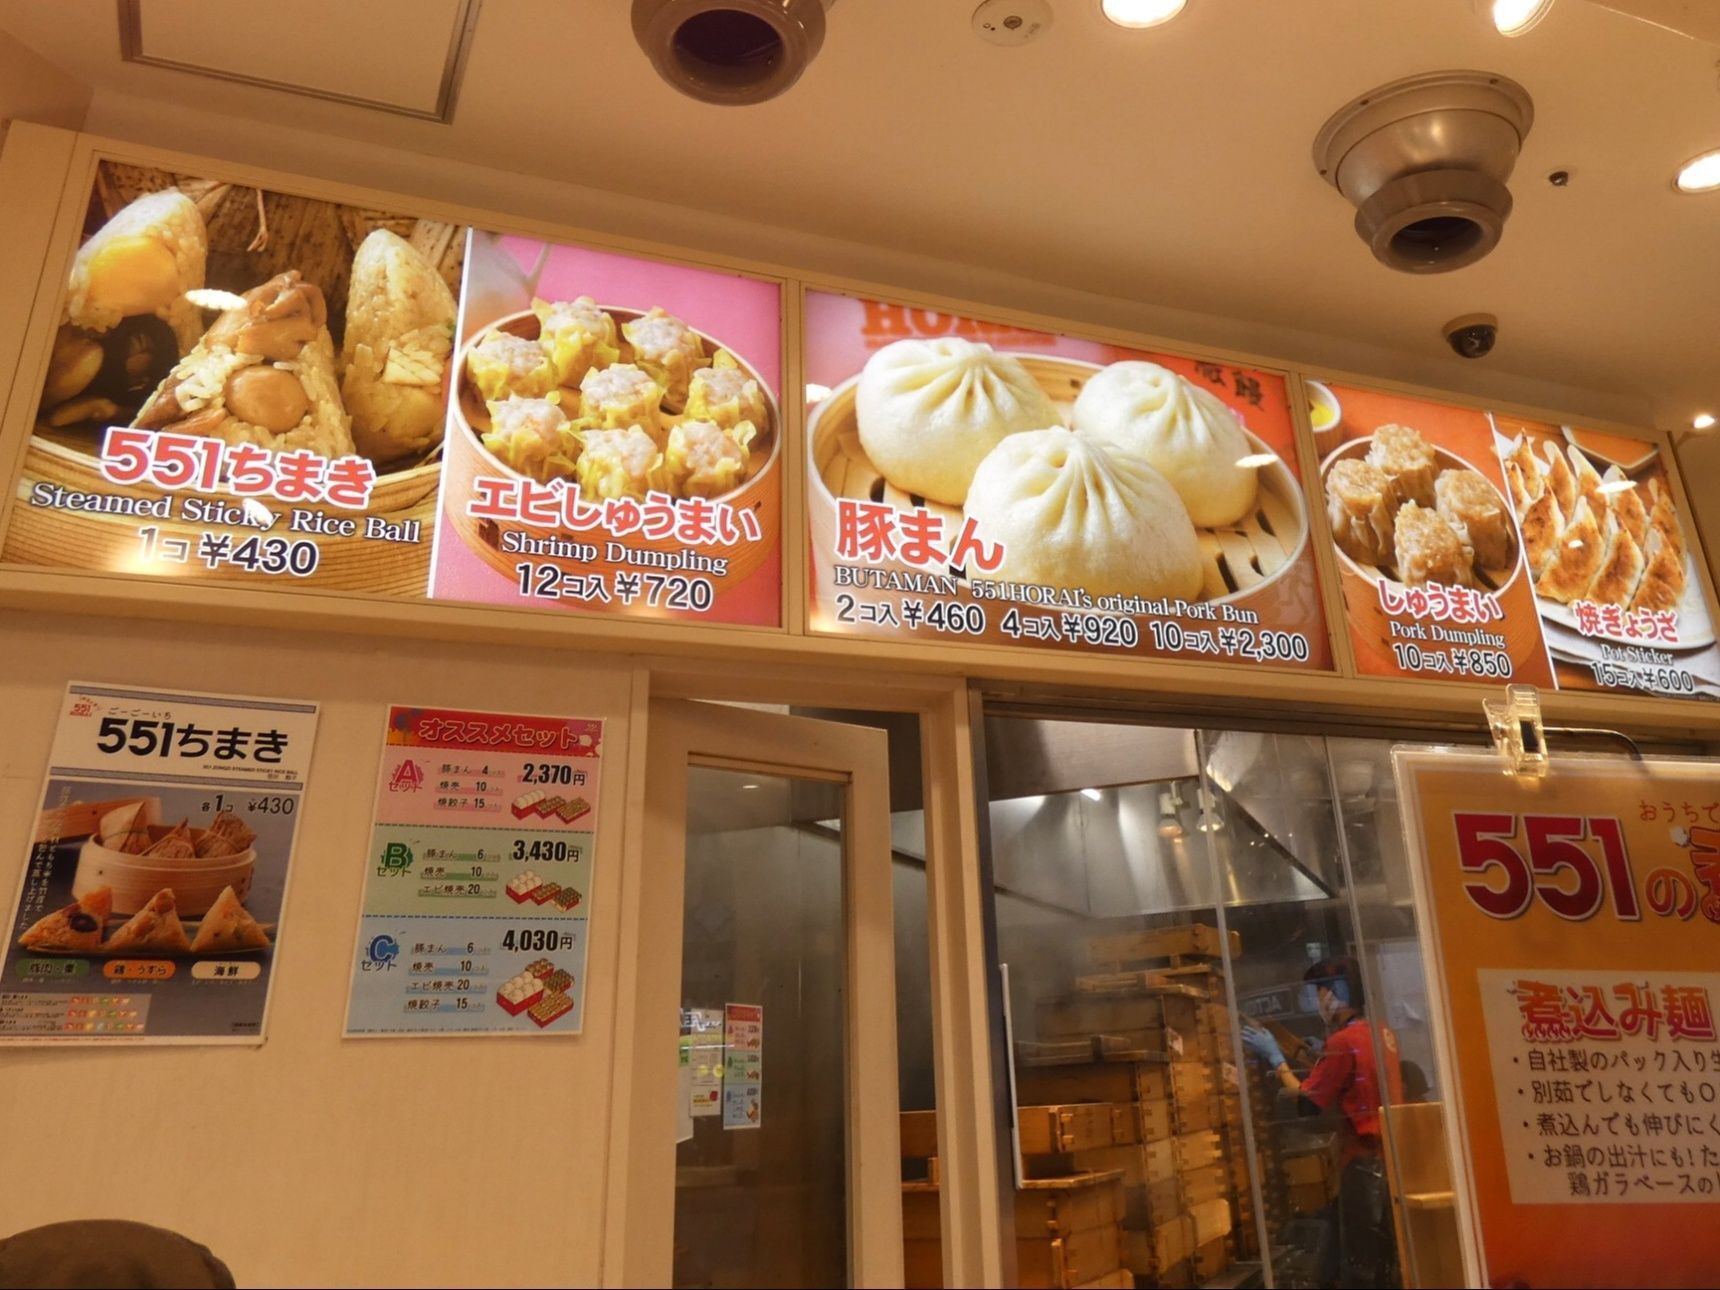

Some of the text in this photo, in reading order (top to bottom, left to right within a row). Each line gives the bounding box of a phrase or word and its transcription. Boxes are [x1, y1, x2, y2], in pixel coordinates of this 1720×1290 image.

[102, 427, 377, 509] 551ちまき
[31, 483, 171, 519] Steamed
[291, 510, 355, 536] Rice
[365, 517, 421, 543] Ball
[467, 477, 762, 547] エビしゅうまい
[199, 533, 320, 577] ¥430
[502, 531, 729, 576] Shrimp Dumpling
[835, 498, 1006, 573] 豚まん
[615, 571, 713, 612] ¥720
[834, 566, 959, 596] BUTAMAN
[1097, 596, 1170, 616] original
[1174, 601, 1217, 620] Pork
[1222, 605, 1259, 624] Bun
[1377, 578, 1504, 623] しゅうまい
[903, 600, 986, 635] ¥460
[1061, 613, 1137, 648] ¥920
[1219, 628, 1309, 662] ¥2,300
[1390, 620, 1506, 649] Pork Dumpling
[1600, 644, 1674, 665] Pot Sticker
[97, 717, 288, 763] 551ちまき
[419, 718, 579, 750] オススメセット
[394, 759, 420, 782] A
[248, 797, 294, 815] ¥430
[1639, 800, 1720, 823] おうちで
[385, 842, 408, 868] B
[369, 935, 396, 961] C
[1517, 980, 1716, 1043] 煮込み麺
[1568, 1171, 1720, 1197] 鶏ガラベースの
